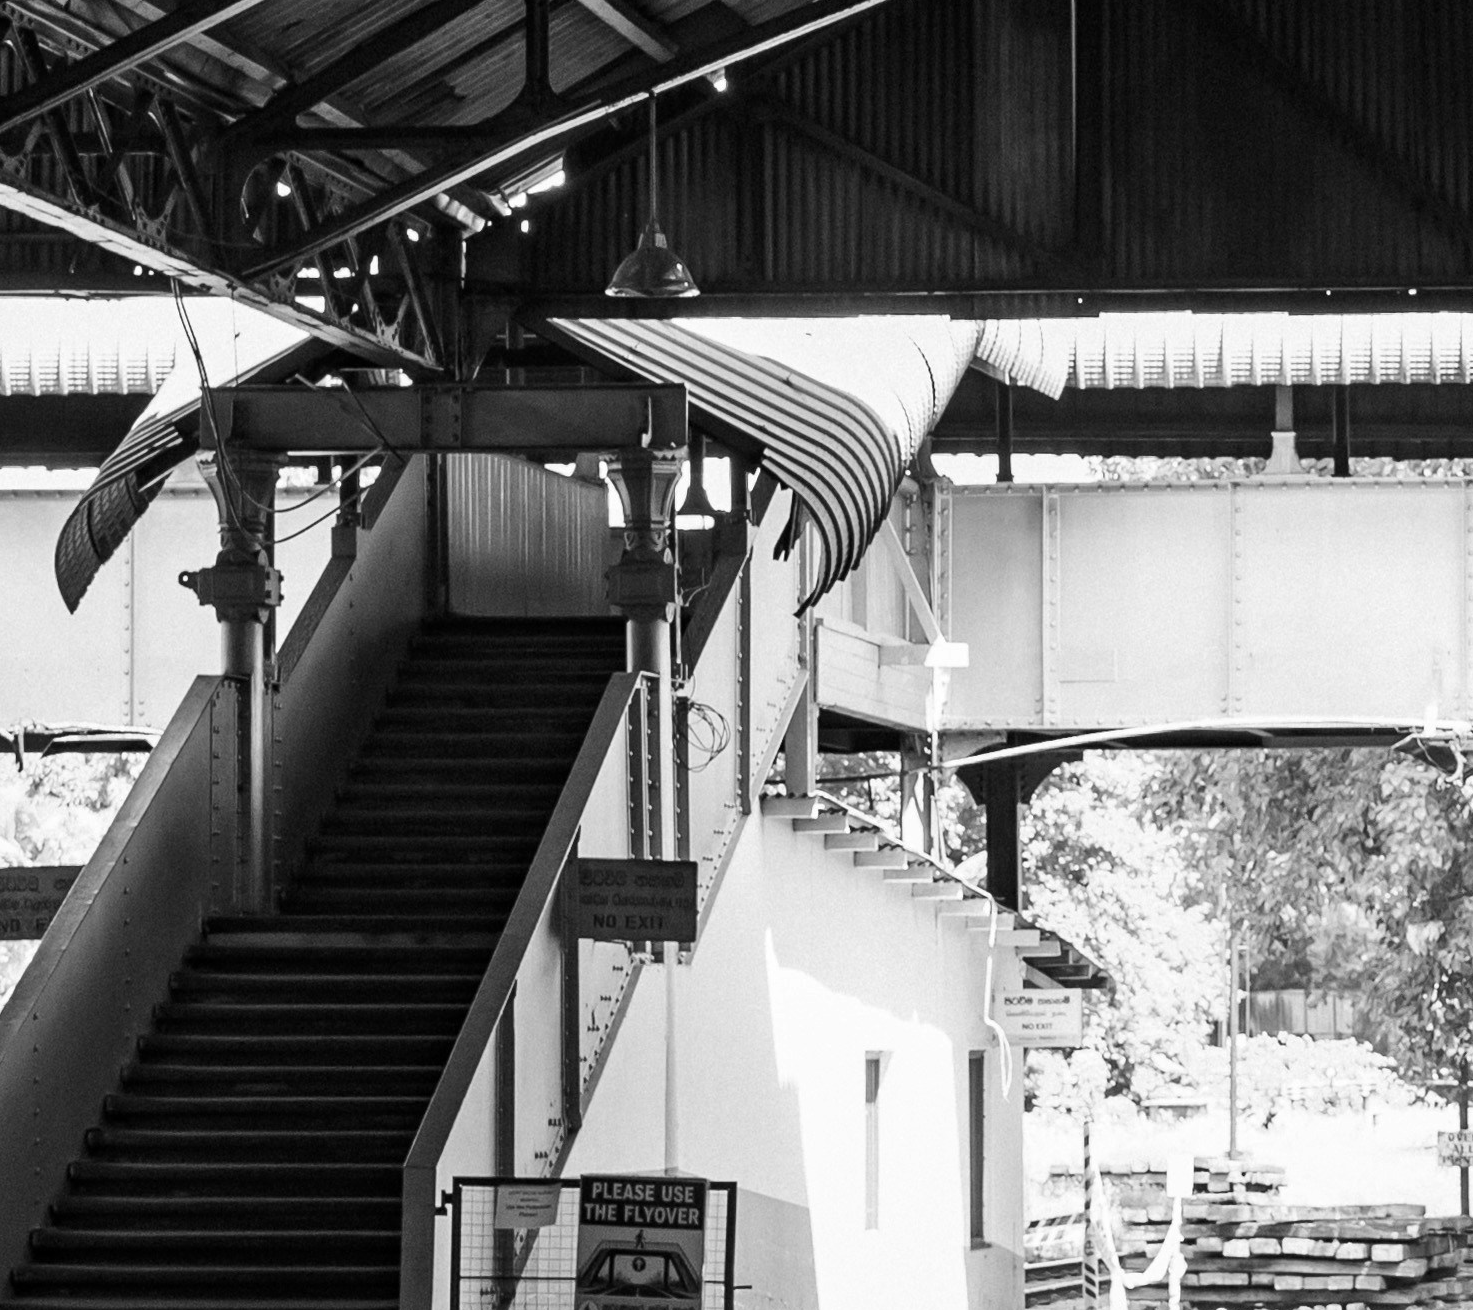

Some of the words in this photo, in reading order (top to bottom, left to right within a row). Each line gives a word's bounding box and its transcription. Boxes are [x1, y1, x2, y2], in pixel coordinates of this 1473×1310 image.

[593, 914, 617, 929] NO
[625, 915, 664, 930] EXIT
[591, 1182, 655, 1202] PLEASE
[661, 1185, 695, 1204] USE
[583, 1203, 618, 1222] THE
[623, 1205, 700, 1227] FLYOVER
